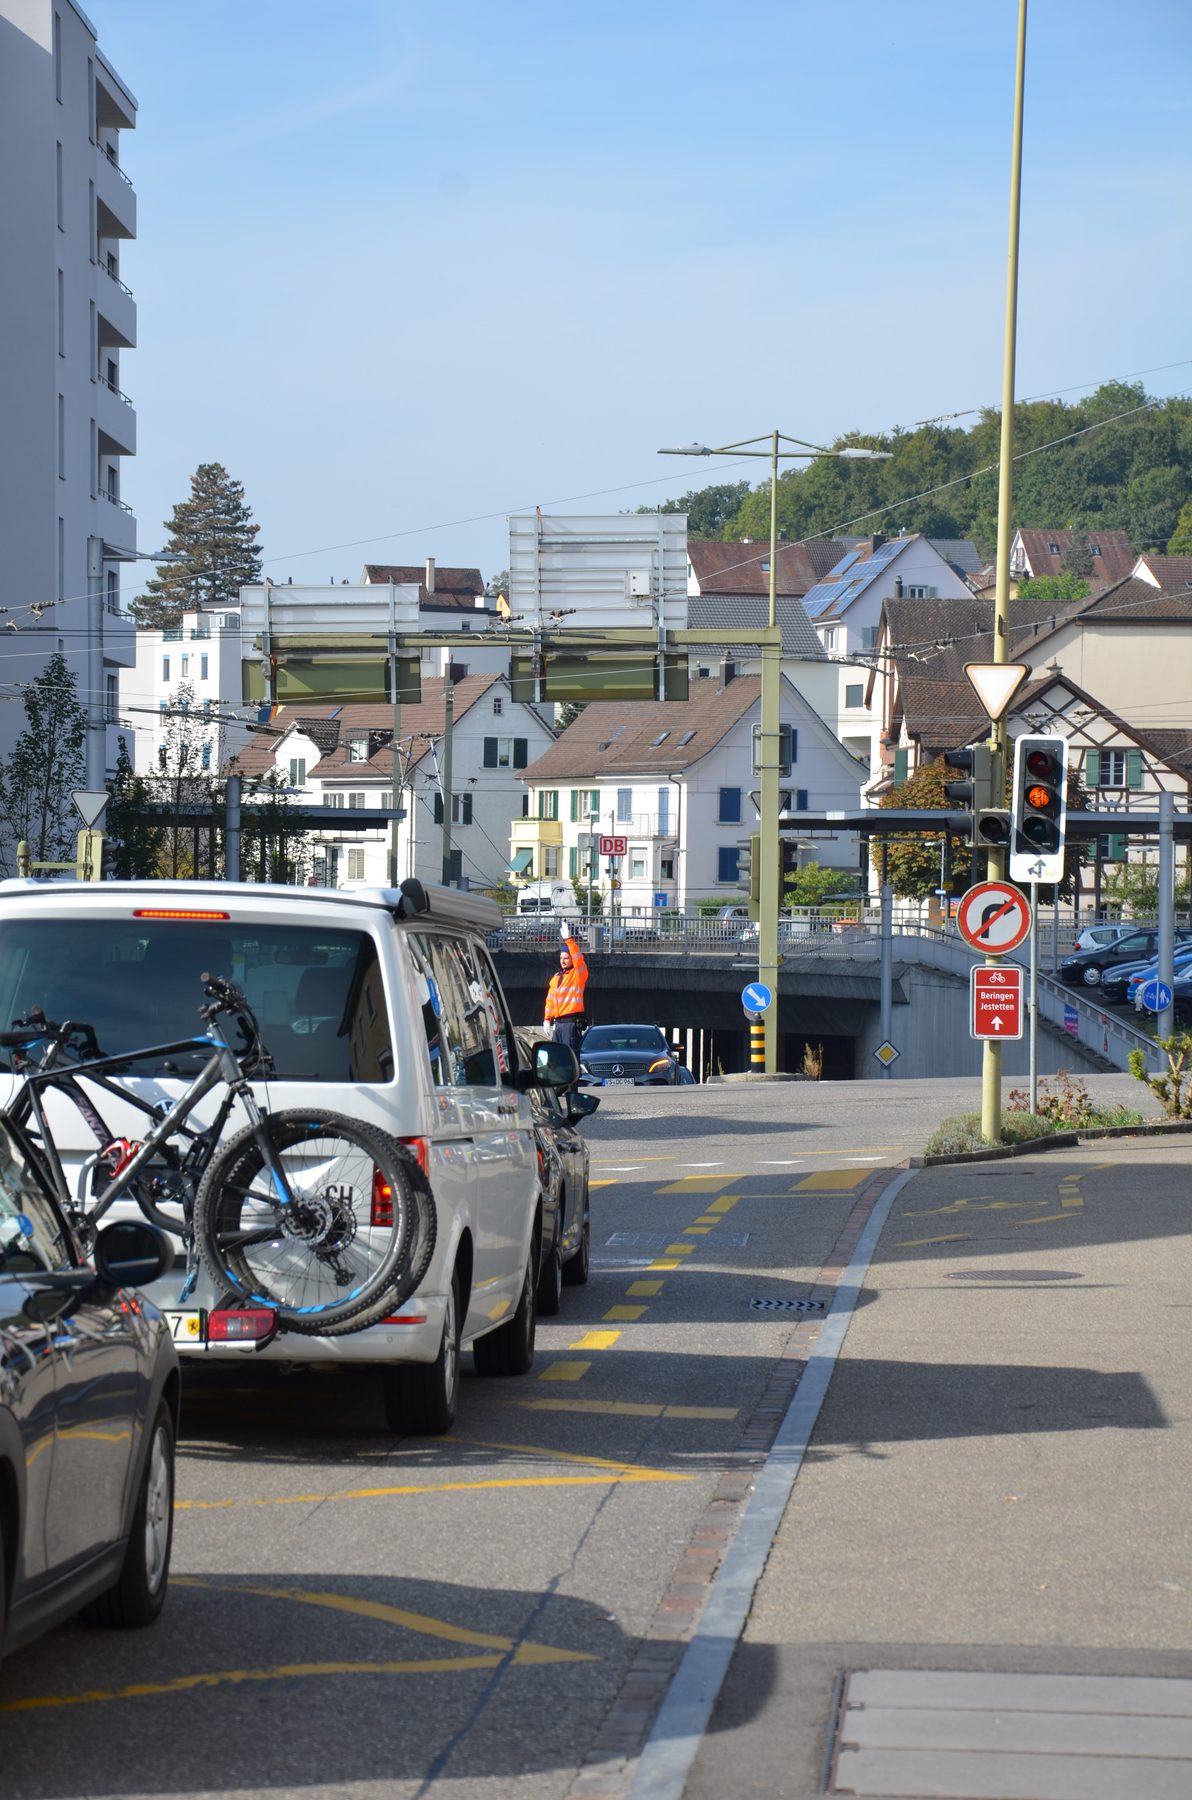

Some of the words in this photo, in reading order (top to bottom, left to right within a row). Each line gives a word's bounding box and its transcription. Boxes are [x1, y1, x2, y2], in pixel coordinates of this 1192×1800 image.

[603, 839, 624, 853] DB
[980, 991, 1014, 1002] Beringen
[980, 1002, 1015, 1010] Jestetten
[325, 1184, 354, 1210] CH
